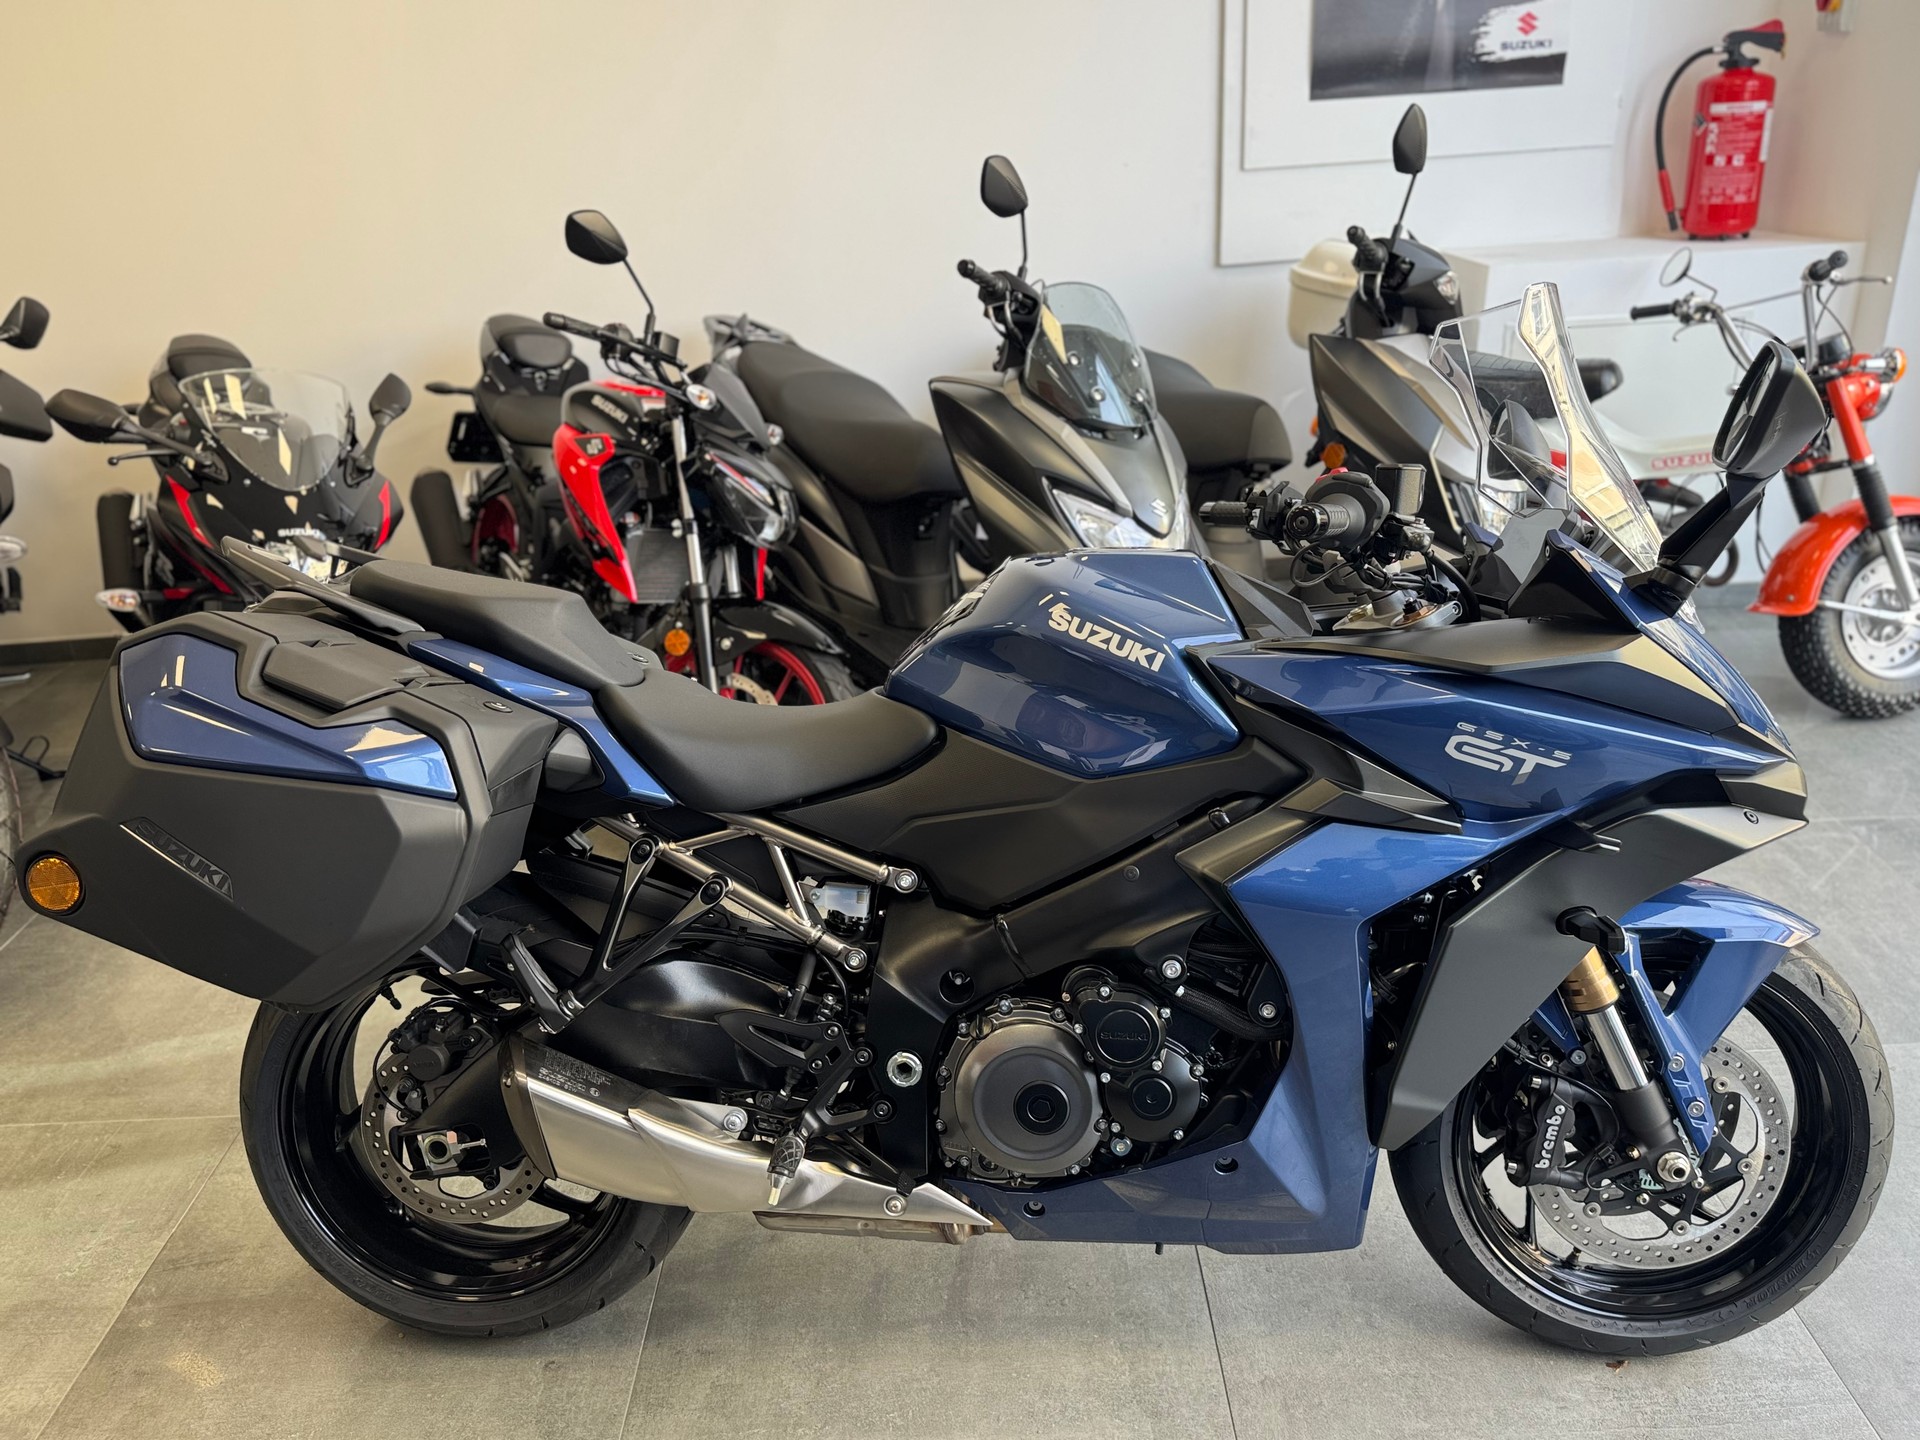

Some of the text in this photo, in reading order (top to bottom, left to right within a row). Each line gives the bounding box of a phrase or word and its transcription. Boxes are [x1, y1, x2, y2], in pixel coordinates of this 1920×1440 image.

[1500, 40, 1552, 51] SUZUKI
[1048, 609, 1166, 672] SUZUKI
[1444, 734, 1568, 786] GT
[135, 822, 230, 892] SUZUKI
[1100, 1031, 1148, 1041] SUZUKI
[1534, 1104, 1566, 1169] brembo
